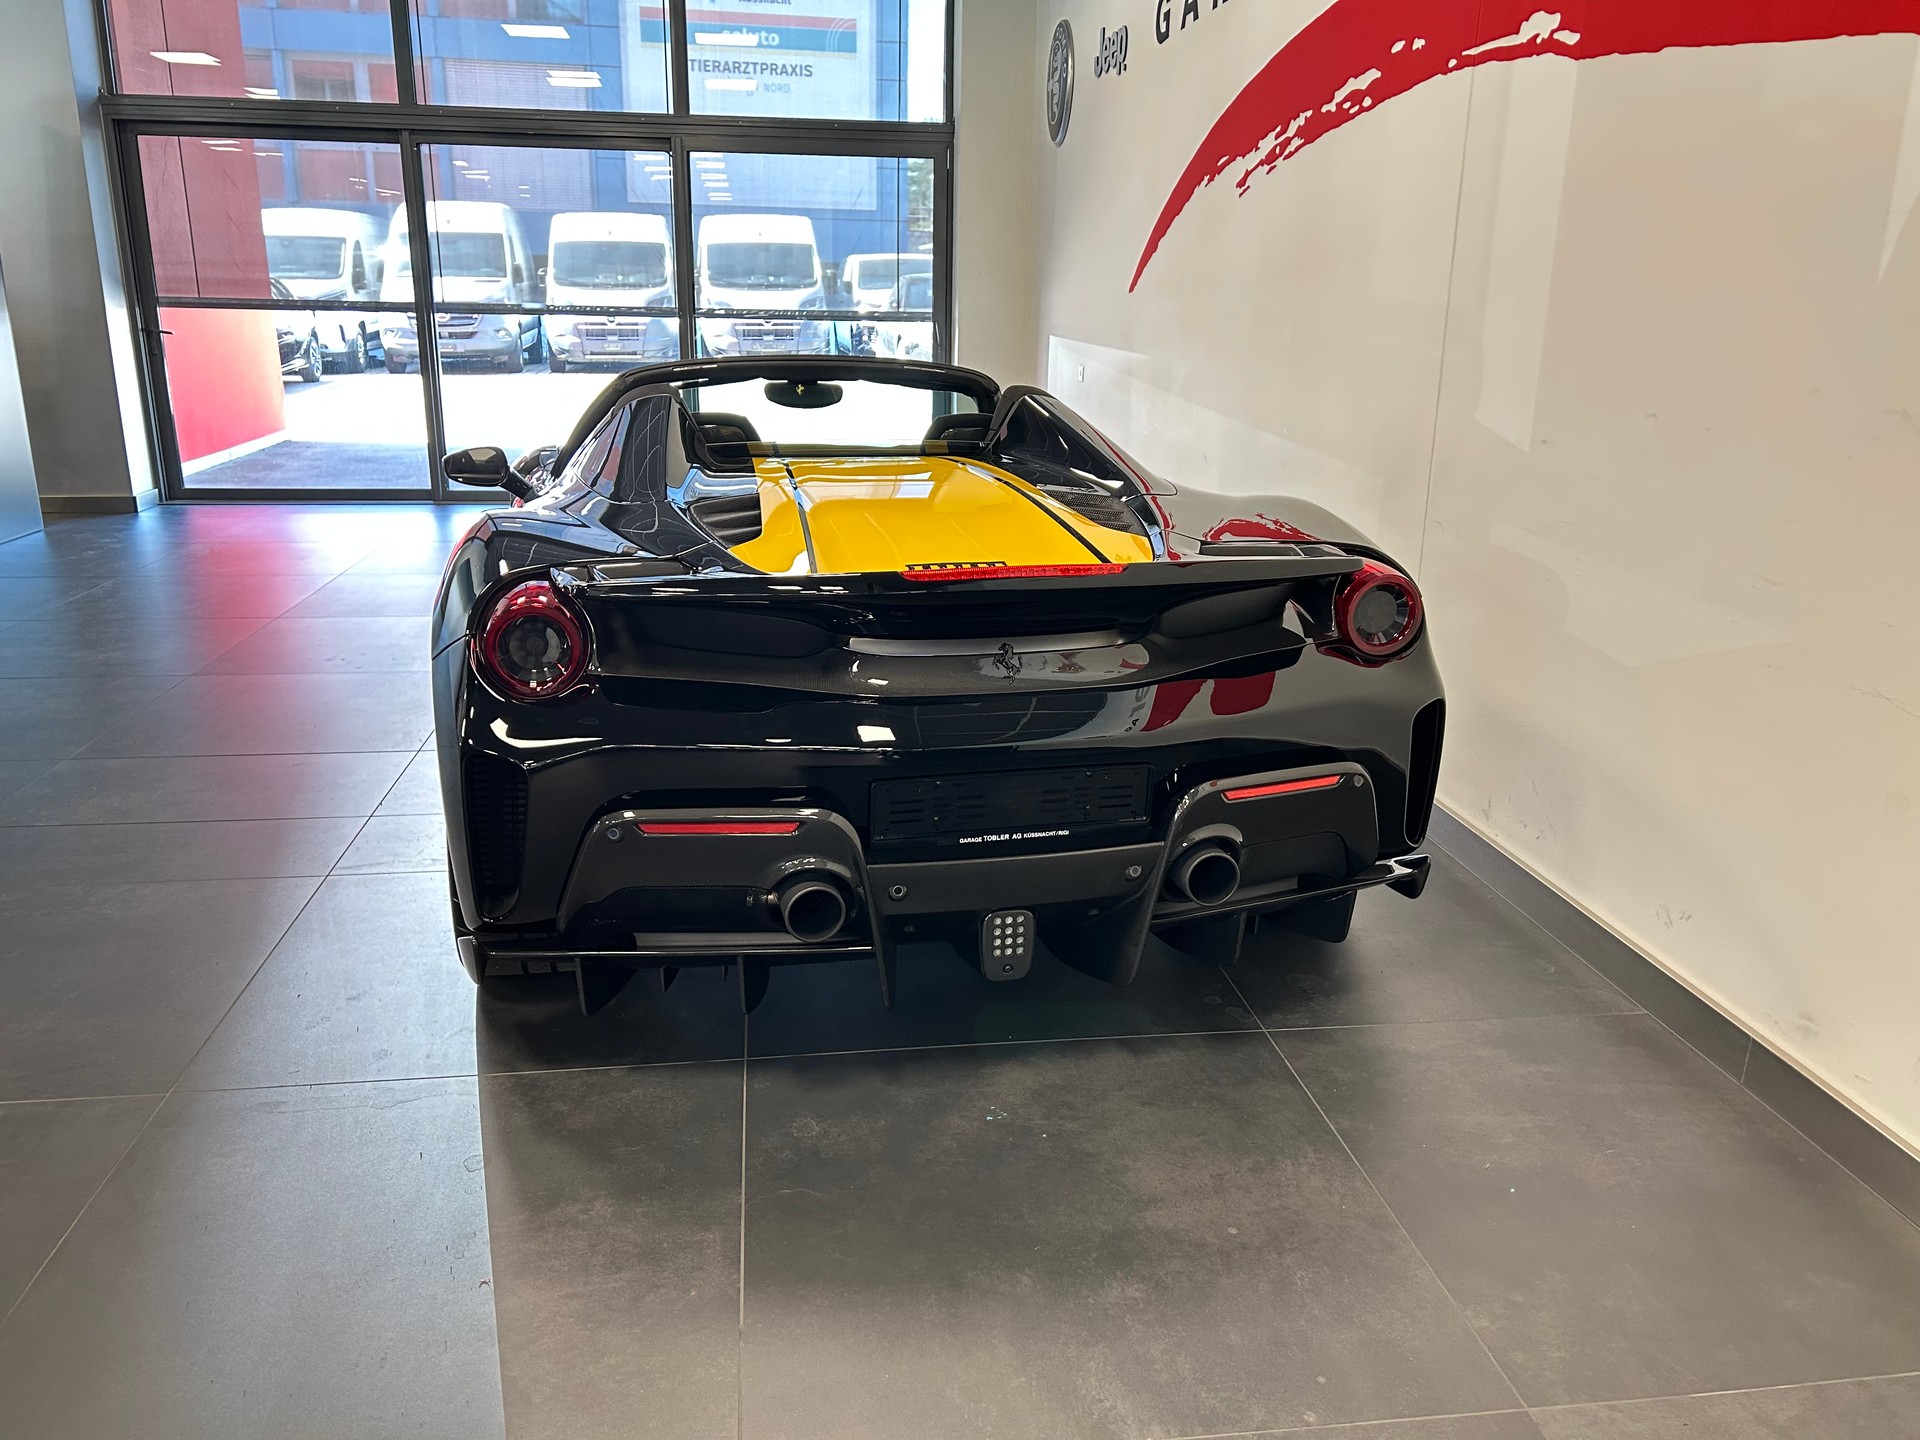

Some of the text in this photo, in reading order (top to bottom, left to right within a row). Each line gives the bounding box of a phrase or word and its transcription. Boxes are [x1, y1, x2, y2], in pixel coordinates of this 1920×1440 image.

[1156, 0, 1229, 45] GA
[1093, 25, 1128, 78] Jeep
[688, 59, 813, 78] TIERARZTPRAXIS
[959, 836, 983, 844] GARAGE
[983, 833, 1010, 842] TOBLER
